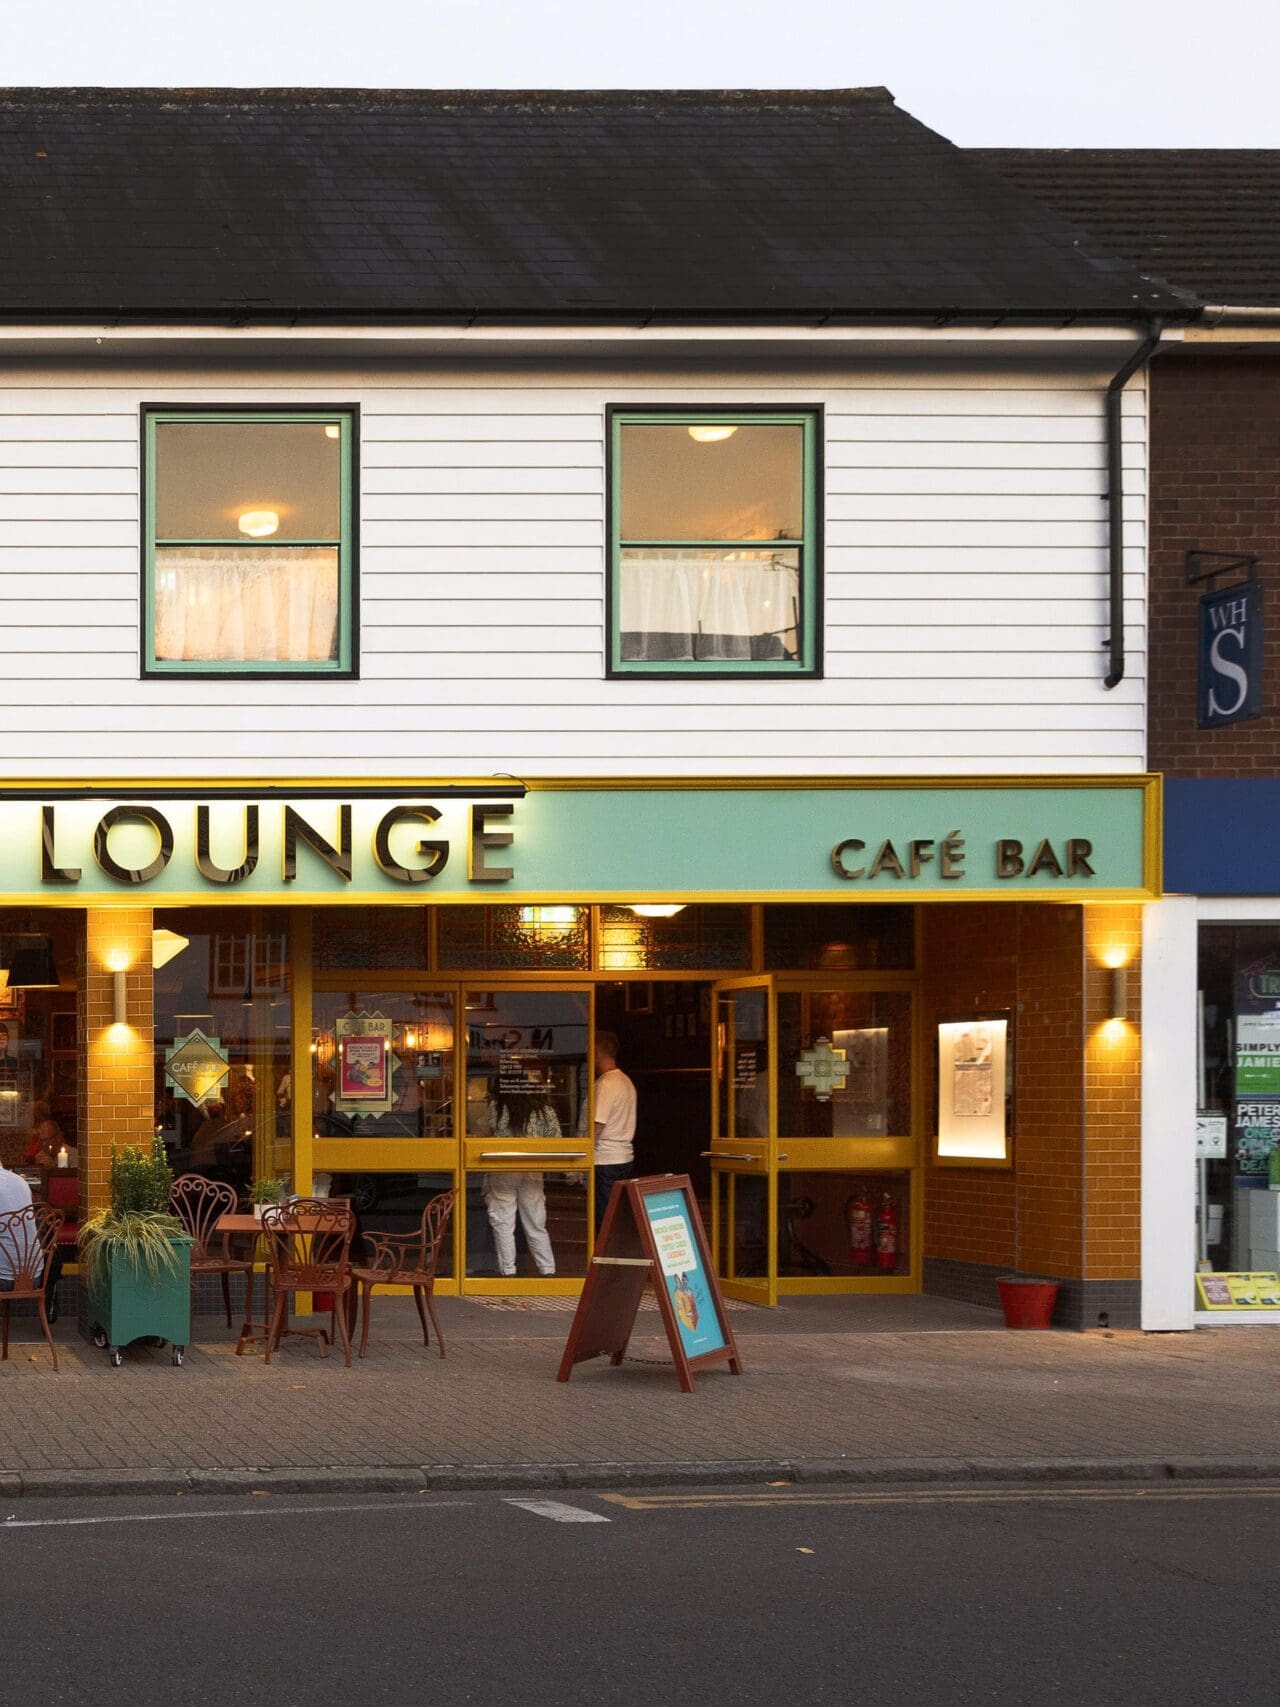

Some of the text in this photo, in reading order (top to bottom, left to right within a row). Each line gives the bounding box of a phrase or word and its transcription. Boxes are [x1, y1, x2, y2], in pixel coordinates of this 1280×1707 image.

[1209, 598, 1248, 630] WH
[1208, 626, 1248, 716] S
[40, 804, 515, 885] LOUNGE
[830, 830, 1096, 880] CAFÉ BAR
[368, 1021, 386, 1032] BAR
[171, 1060, 198, 1073] CAFÉ
[1237, 1104, 1280, 1116] PETER
[1235, 1116, 1280, 1128] JAMES
[1240, 1160, 1268, 1171] DEA
